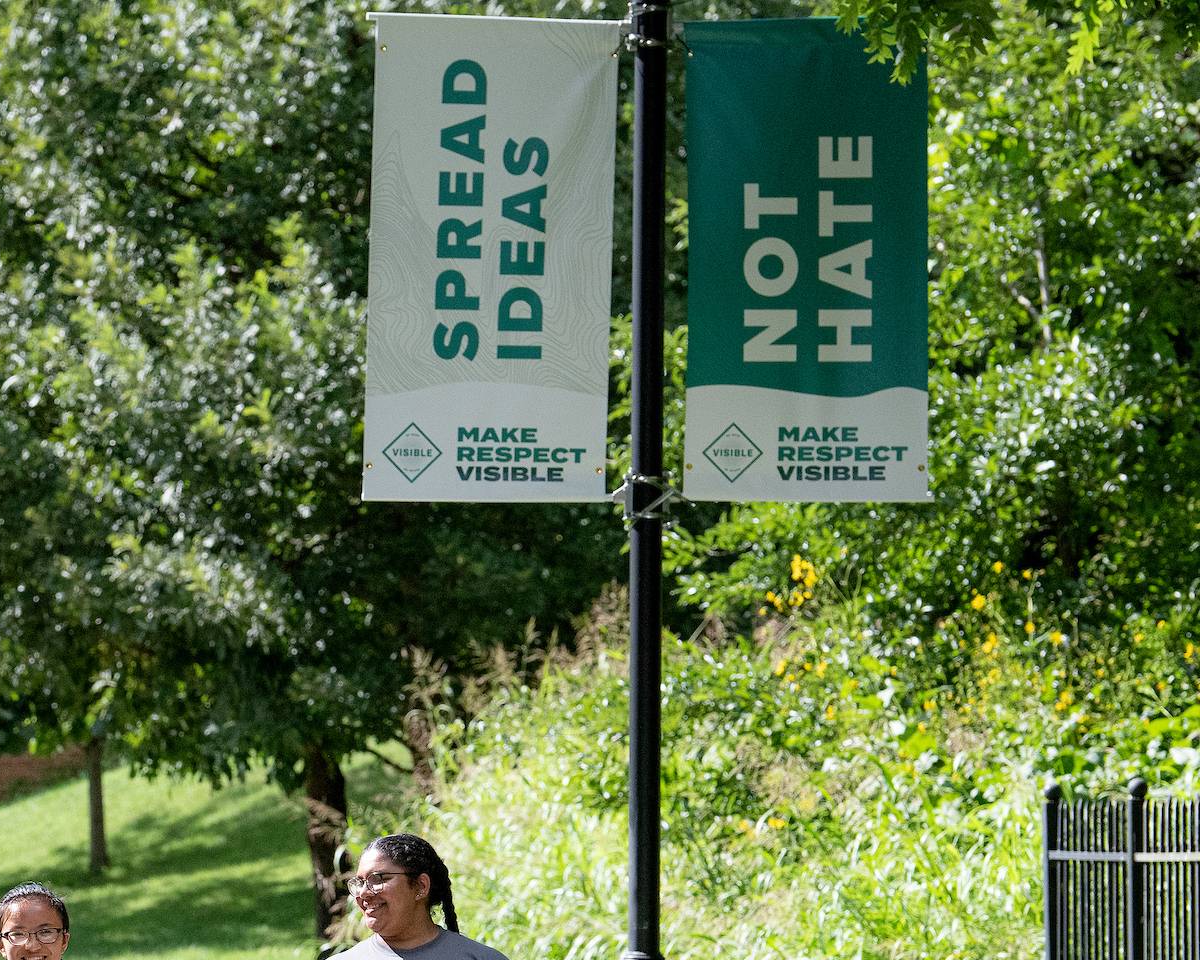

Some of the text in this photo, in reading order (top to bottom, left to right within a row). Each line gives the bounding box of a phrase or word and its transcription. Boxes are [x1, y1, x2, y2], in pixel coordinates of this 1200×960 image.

[433, 59, 488, 362] SPREAD
[496, 136, 550, 360] IDEAS
[818, 135, 874, 362] HATE
[743, 183, 799, 362] NOT
[457, 427, 538, 443] MAKE
[778, 426, 859, 442] MAKE
[392, 448, 433, 458] VISIBLE
[456, 446, 587, 464] RESPECT
[712, 448, 754, 458] VISIBLE
[777, 446, 909, 462] RESPECT
[456, 466, 564, 482] VISIBLE
[776, 466, 886, 481] VISIBLE
